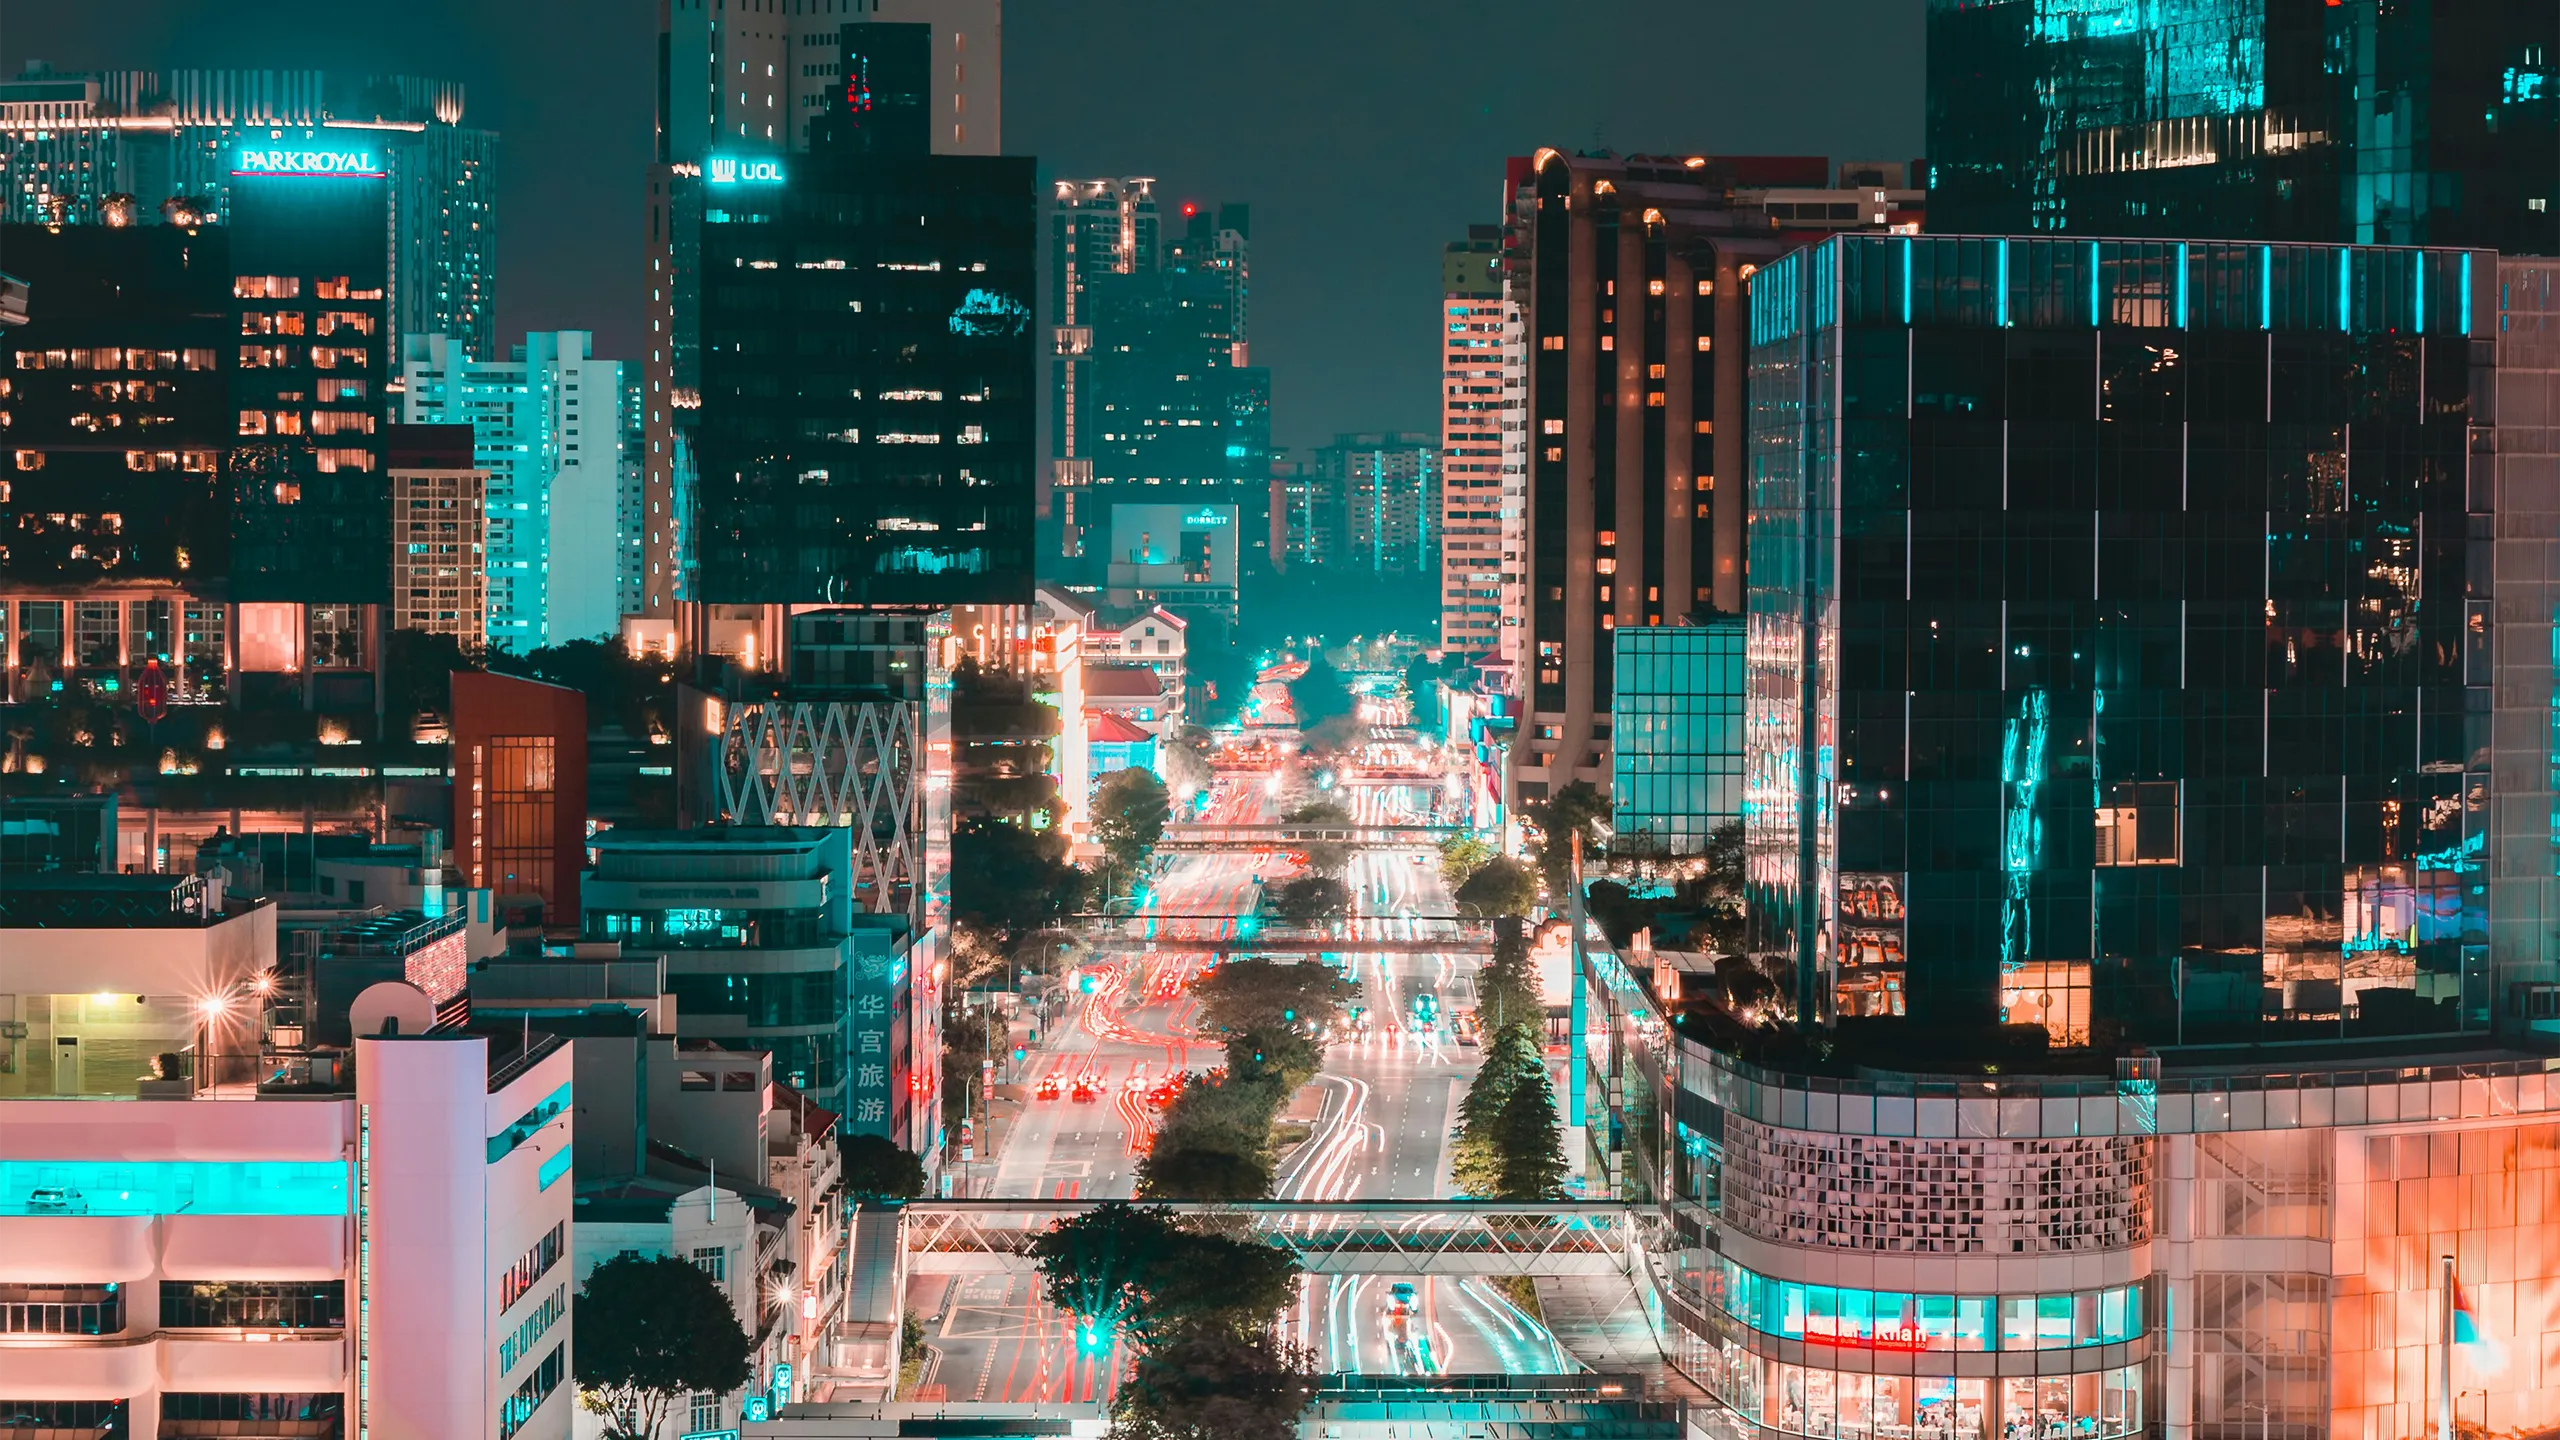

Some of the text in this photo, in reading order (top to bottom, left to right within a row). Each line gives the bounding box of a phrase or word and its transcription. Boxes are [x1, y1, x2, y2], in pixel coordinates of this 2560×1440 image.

[241, 150, 376, 171] PARKROYAL
[741, 163, 783, 180] UOL
[1187, 516, 1228, 524] DORSETT
[858, 994, 885, 1123] 华宫旅游
[499, 1281, 566, 1379] THE RIVERWALK
